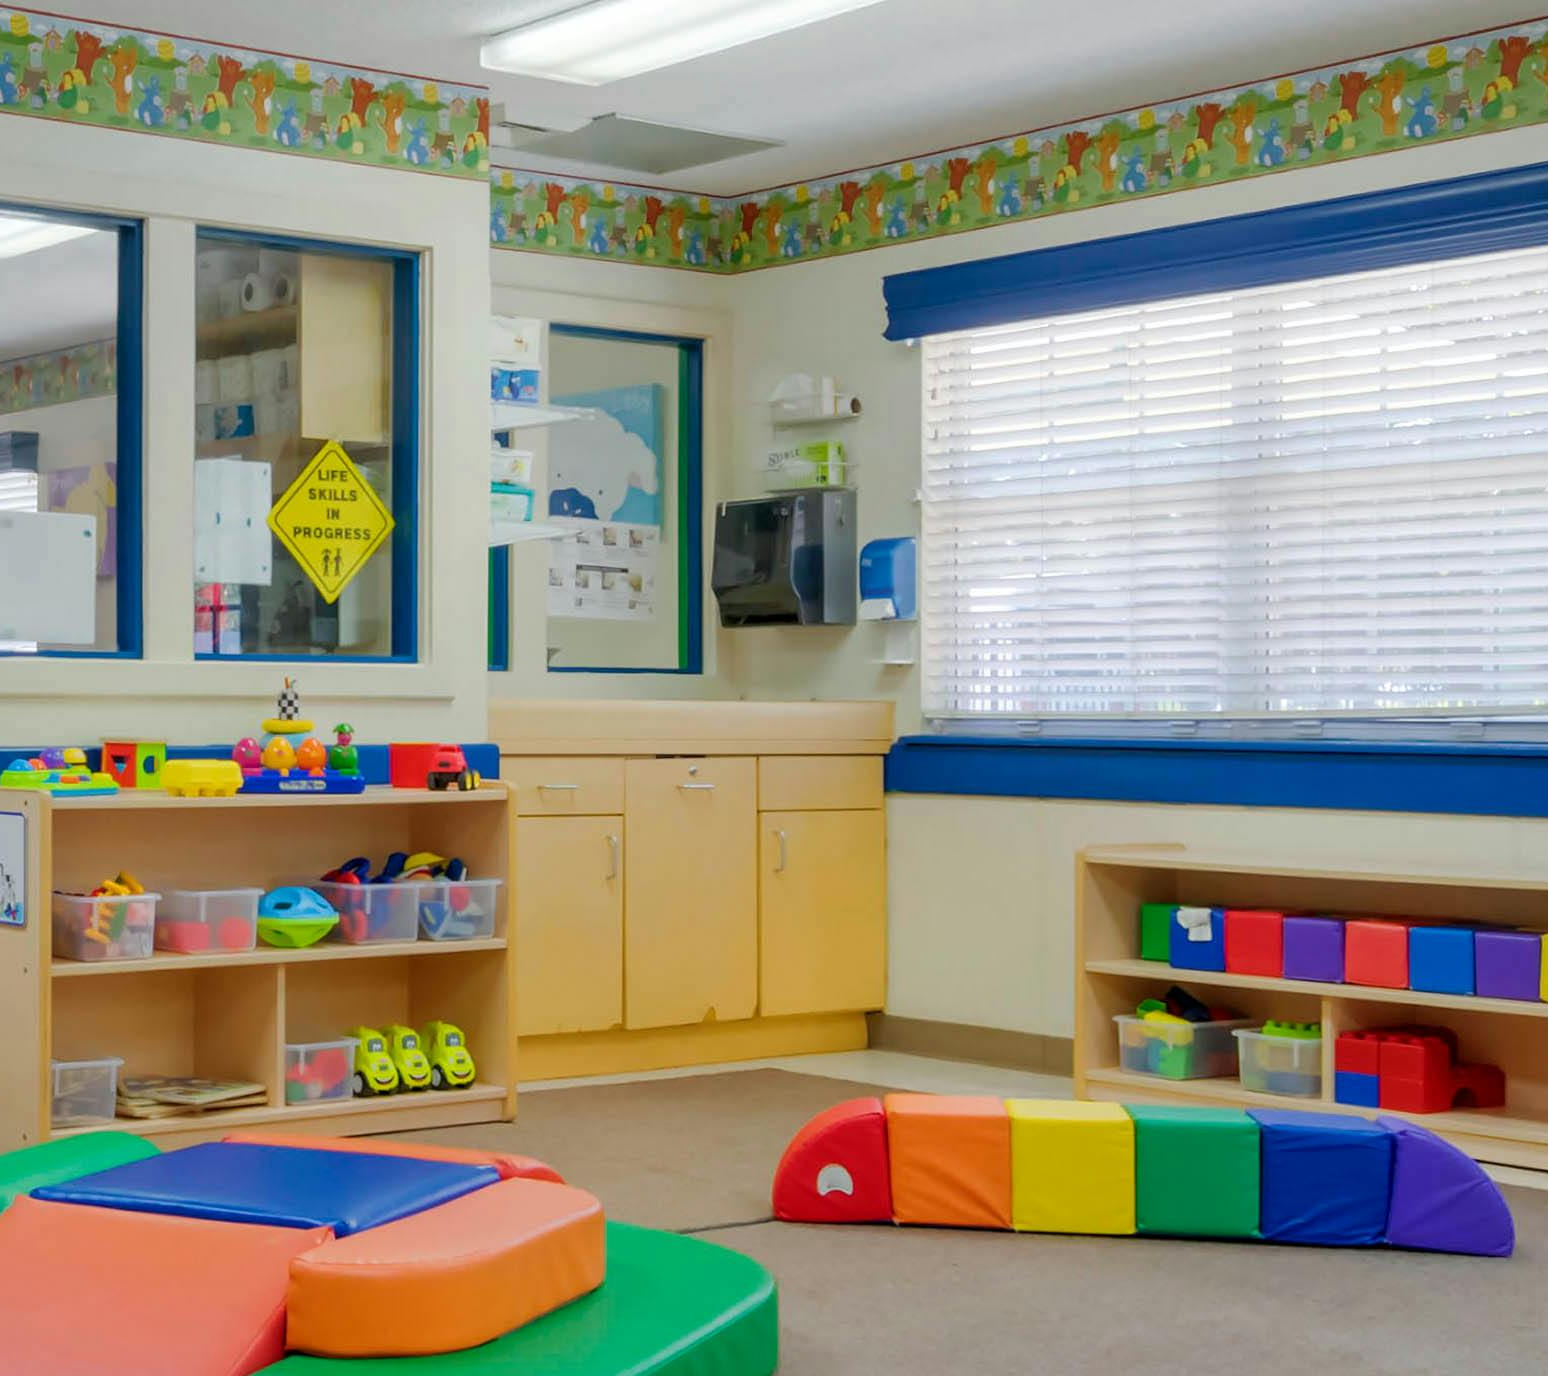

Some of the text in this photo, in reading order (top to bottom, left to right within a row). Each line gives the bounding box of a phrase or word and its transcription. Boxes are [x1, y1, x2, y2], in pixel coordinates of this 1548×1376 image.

[317, 469, 348, 482] LIFE
[308, 488, 358, 502] SKILLS
[326, 508, 341, 521] IN
[292, 526, 372, 541] PROGRESS
